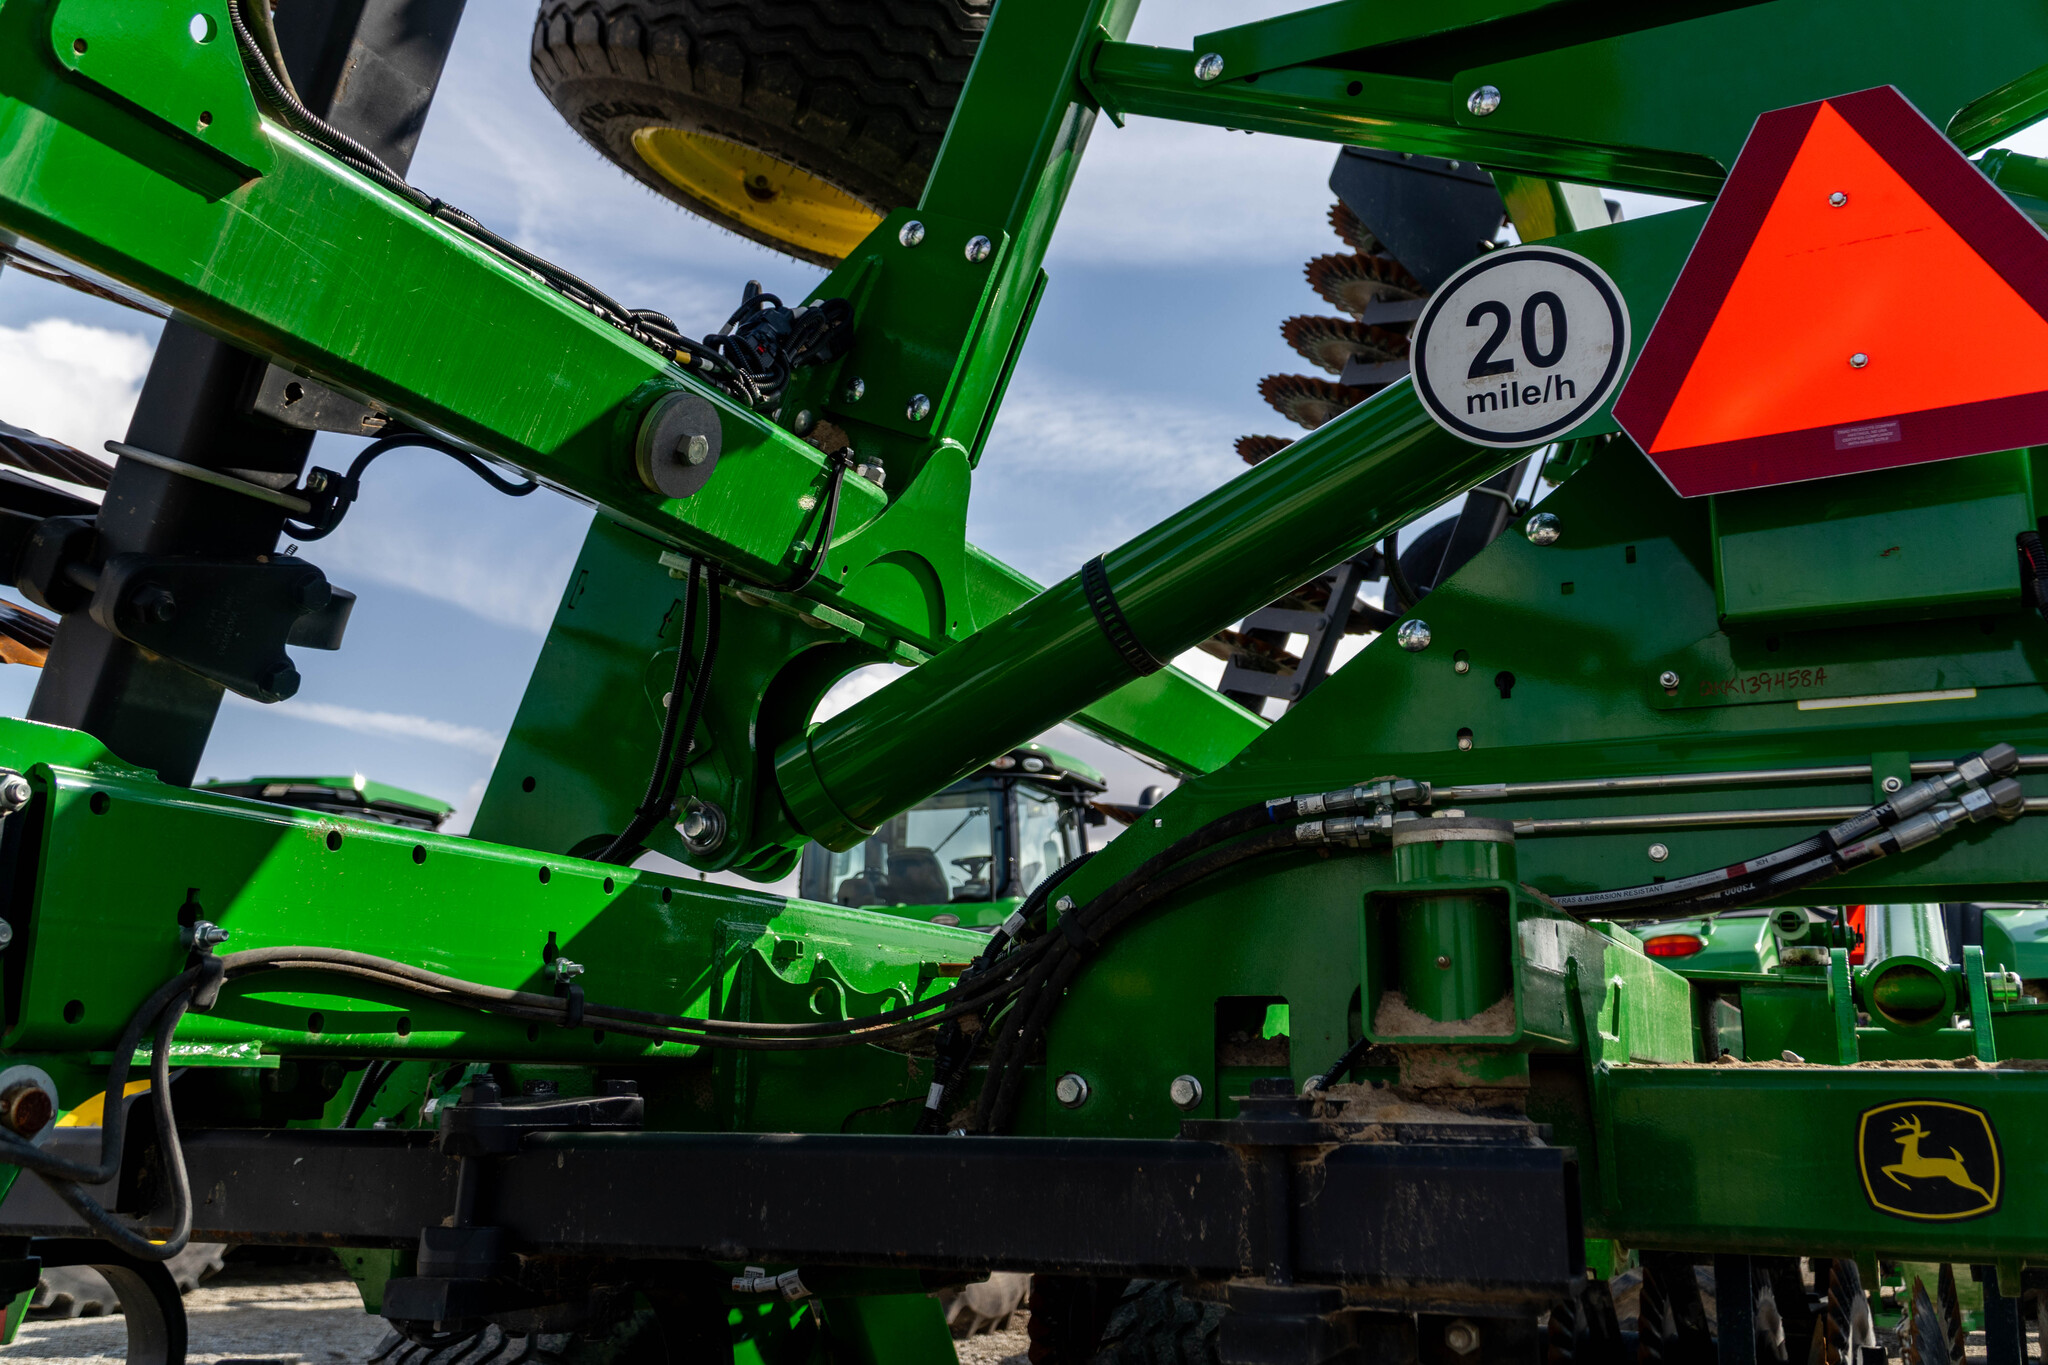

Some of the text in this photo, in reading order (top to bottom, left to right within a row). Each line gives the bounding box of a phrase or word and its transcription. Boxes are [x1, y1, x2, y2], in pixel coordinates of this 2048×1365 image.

[1466, 290, 1568, 380] 20
[1467, 374, 1576, 415] mile/h
[1584, 890, 1622, 904] ABRASION
[1622, 884, 1665, 898] RESISTANT
